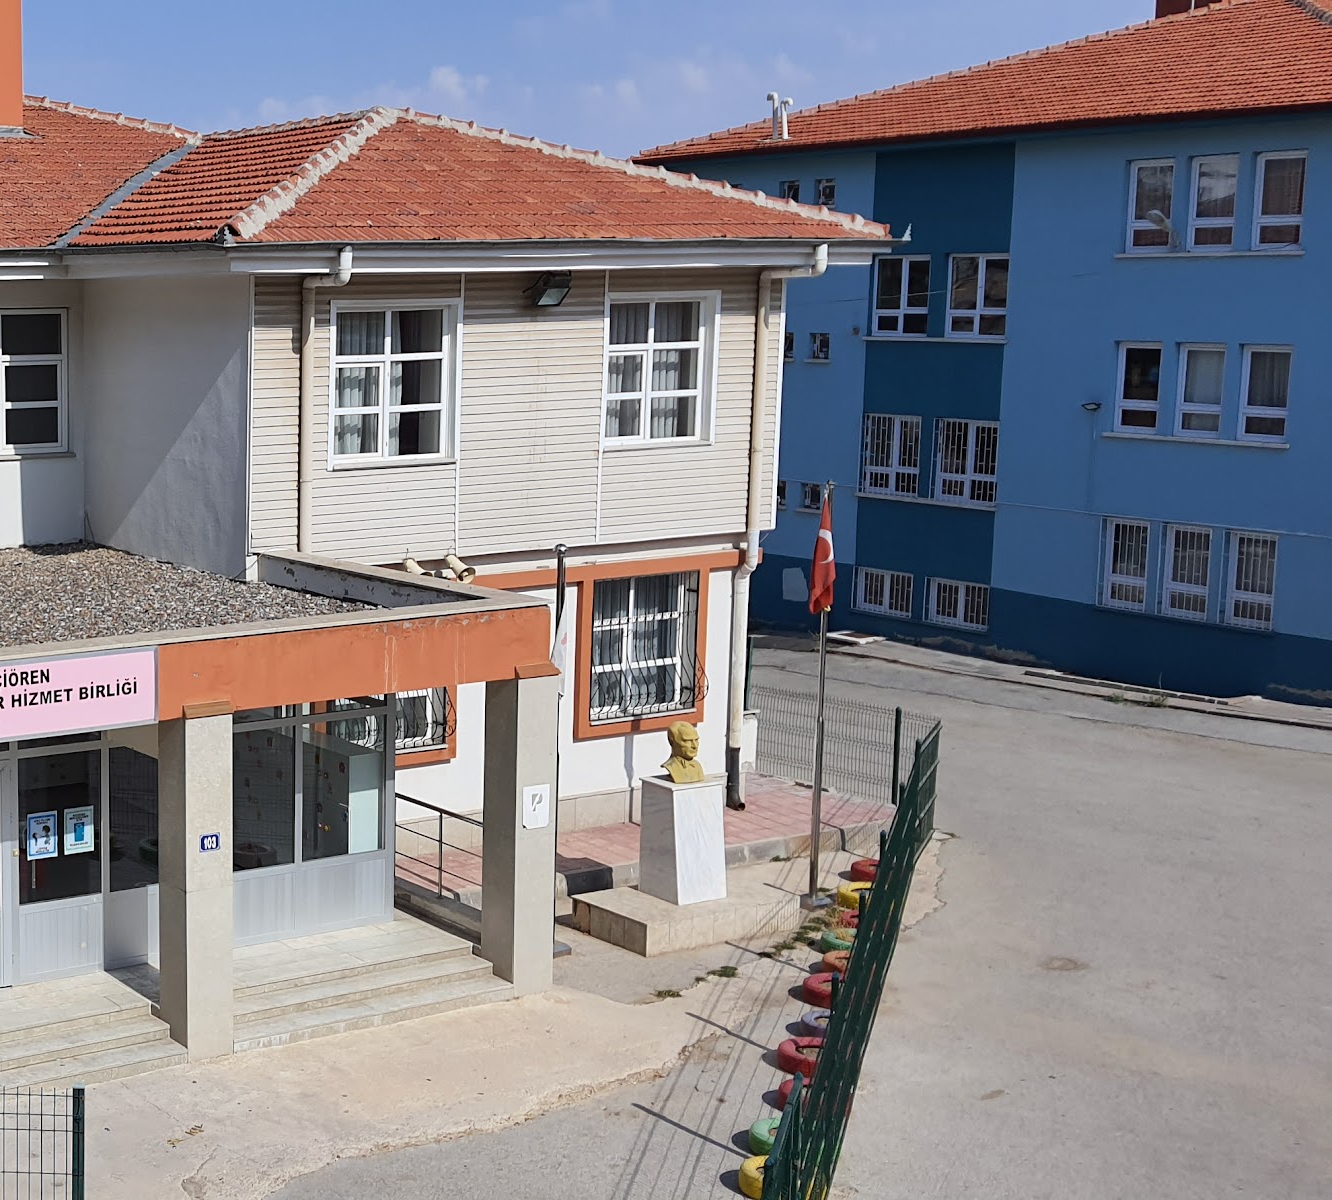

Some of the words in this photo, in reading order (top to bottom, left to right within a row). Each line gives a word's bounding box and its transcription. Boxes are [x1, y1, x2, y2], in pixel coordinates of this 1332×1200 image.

[11, 689, 73, 708] HİZMET
[79, 677, 137, 700] BİRLİĞİ
[204, 836, 216, 850] 103
